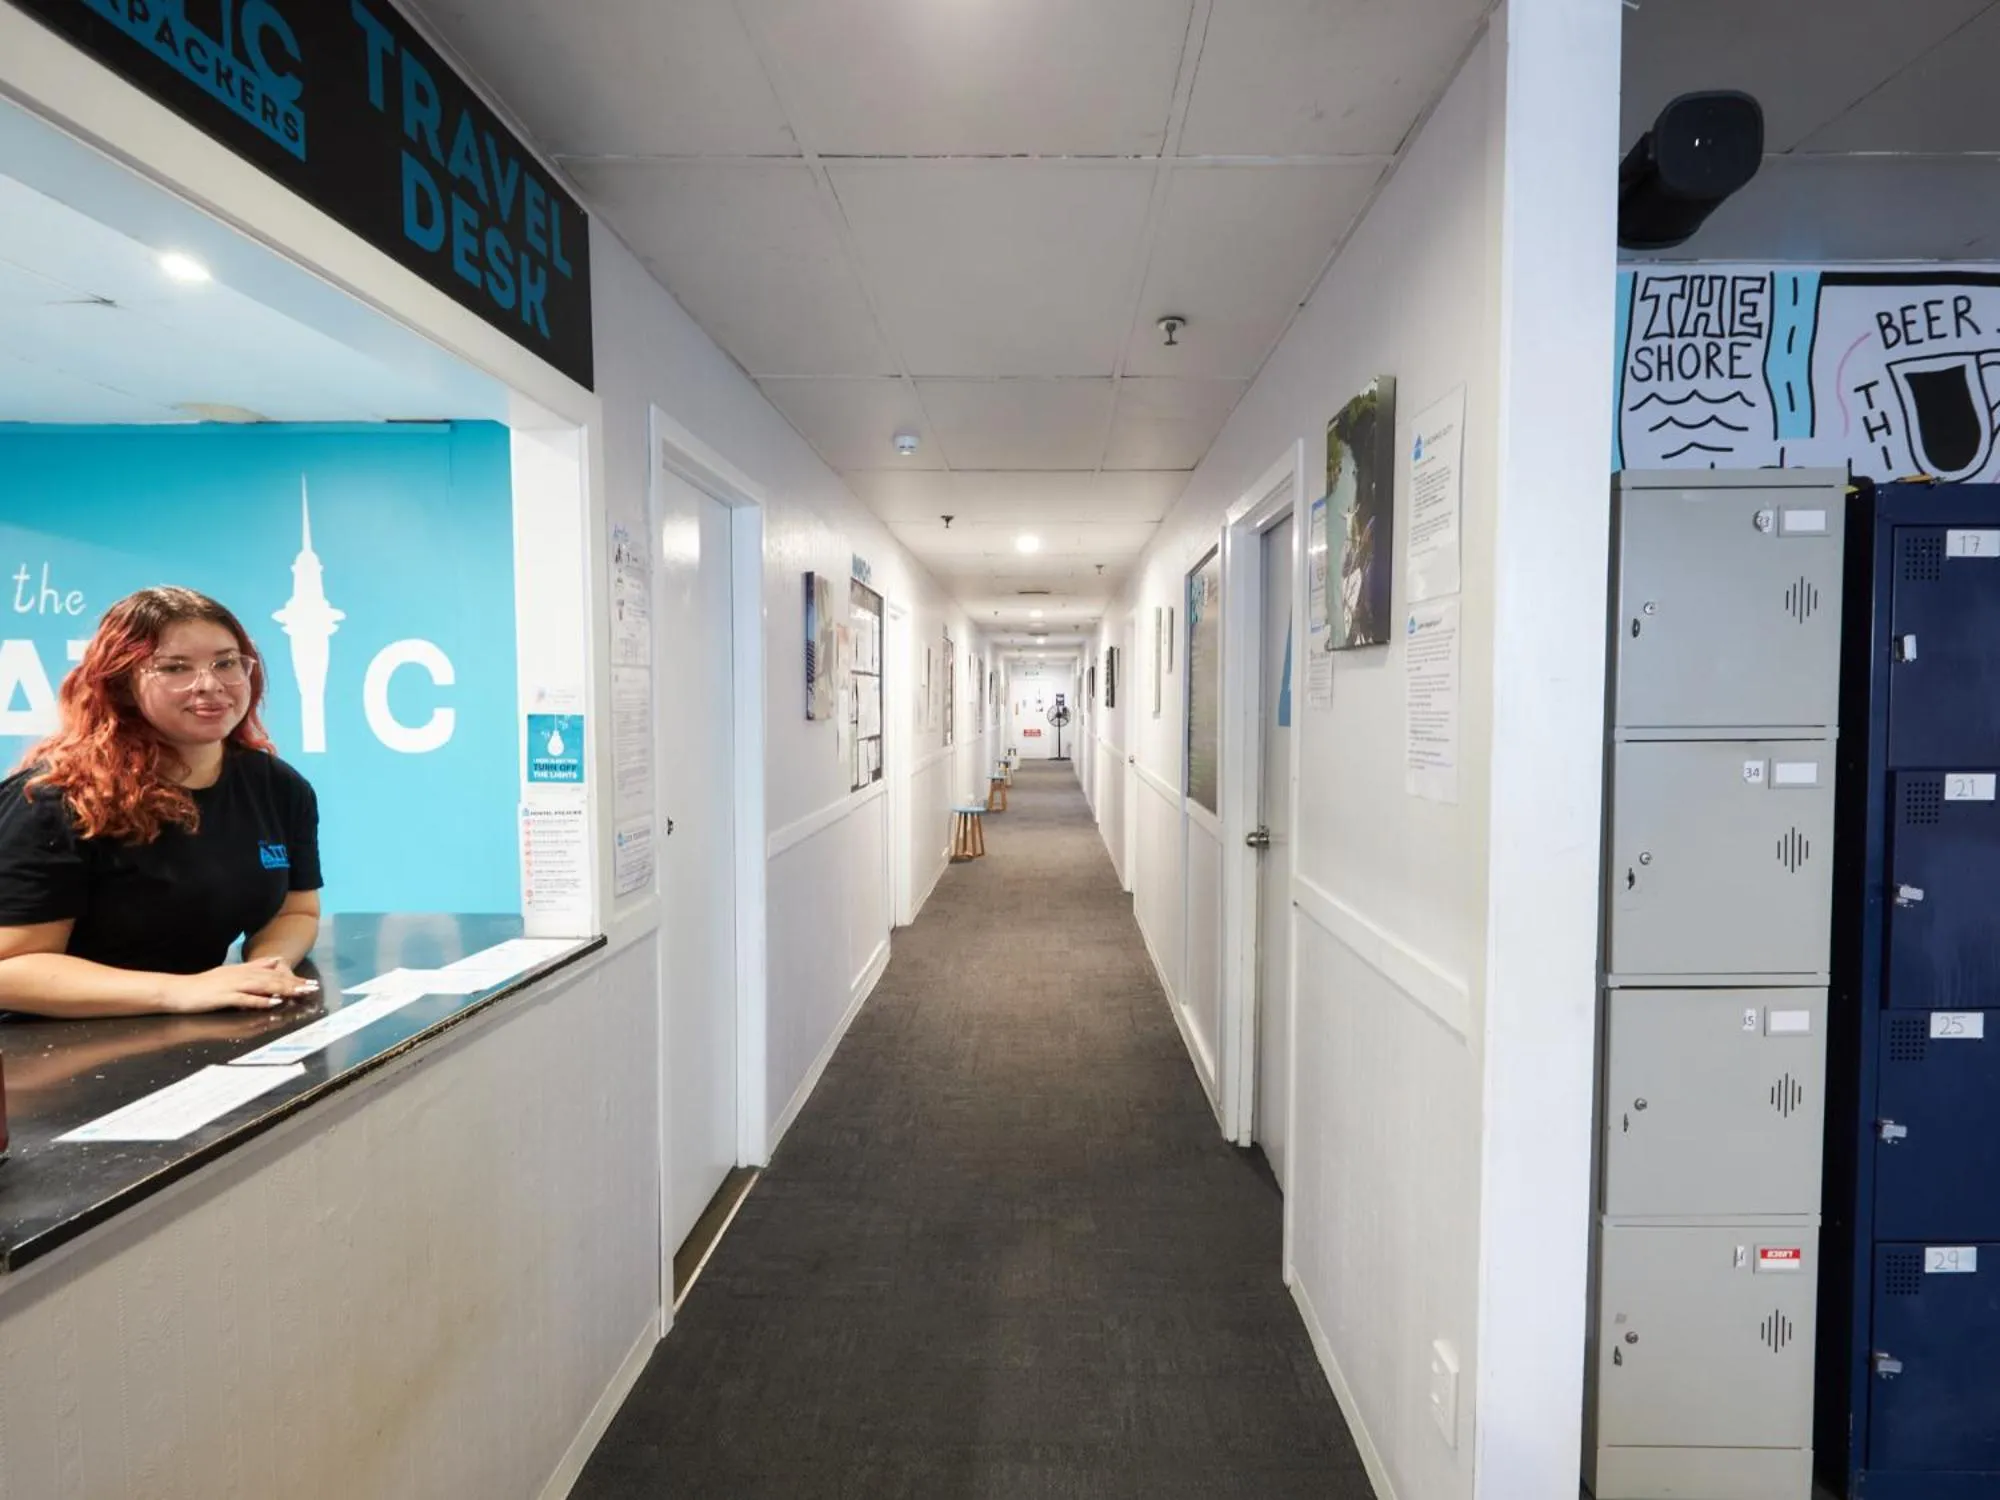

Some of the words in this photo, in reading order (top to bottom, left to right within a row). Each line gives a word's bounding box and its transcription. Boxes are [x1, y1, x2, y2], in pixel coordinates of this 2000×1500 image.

[351, 0, 573, 280] TRAVEL
[402, 150, 550, 340] DESK
[1640, 274, 1766, 340] THE
[1875, 295, 1982, 351] BEER
[1629, 342, 1752, 382] SHORE
[1959, 535, 1981, 555] 17
[12, 562, 87, 616] the
[1953, 778, 1975, 797] 21
[1940, 1015, 1966, 1035] 25
[1934, 1250, 1959, 1270] 29
